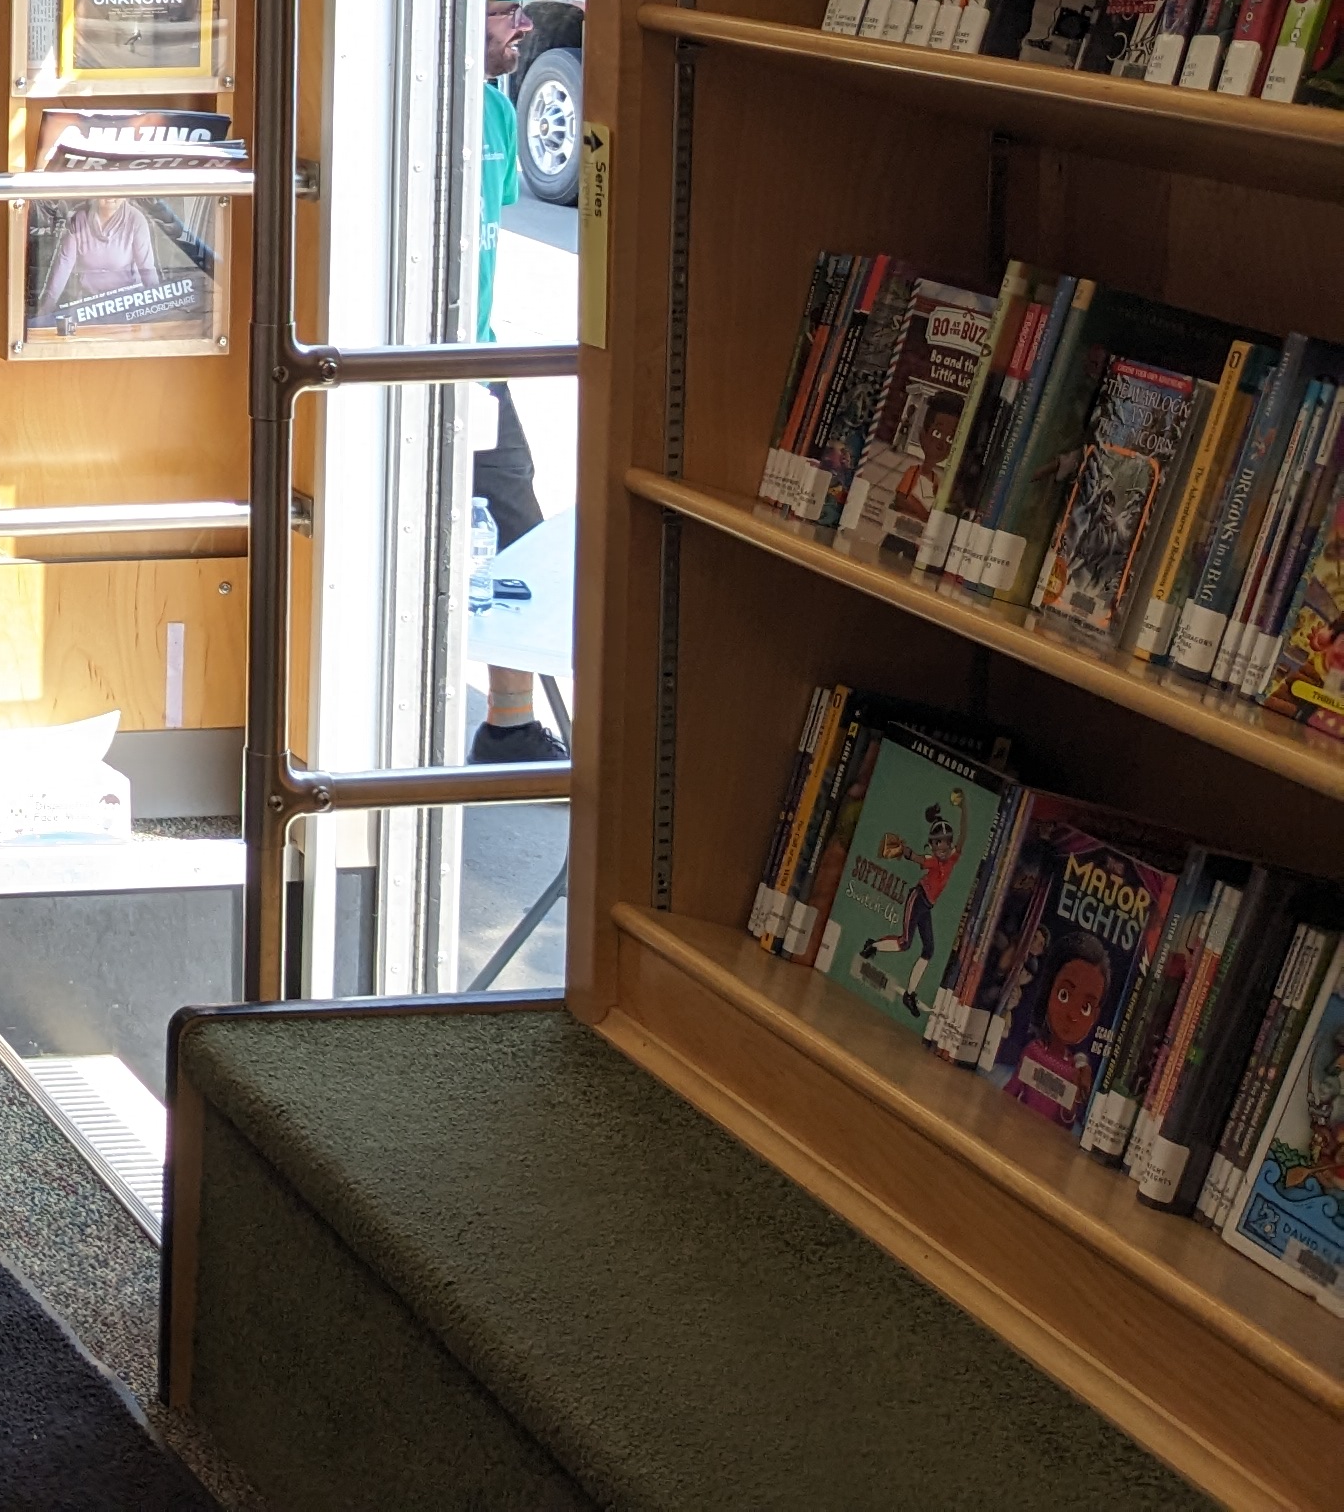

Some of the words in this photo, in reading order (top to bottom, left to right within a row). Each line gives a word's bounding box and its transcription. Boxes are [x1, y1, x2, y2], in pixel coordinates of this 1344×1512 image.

[593, 160, 606, 217] Series
[77, 279, 194, 322] ENTREPRENEUR
[125, 295, 196, 321] EXTRAORDINAIRE
[932, 317, 950, 336] BO
[950, 328, 961, 336] THE
[952, 321, 961, 329] AT
[930, 349, 942, 364] Bo
[943, 355, 964, 370] and
[930, 365, 957, 384] Little
[1107, 378, 1131, 399] THE
[1131, 387, 1191, 419] WARLOCK
[1192, 465, 1205, 483] The
[1175, 483, 1199, 534] Adventures
[1221, 469, 1255, 544] DRAGONS
[1218, 544, 1231, 558] in
[1198, 568, 1222, 603] BAG
[840, 739, 852, 762] JAKE
[911, 740, 935, 760] JAKE
[936, 753, 977, 781] MADDOX
[851, 855, 909, 905] SOFTBALL
[1063, 851, 1151, 929] MAJOR
